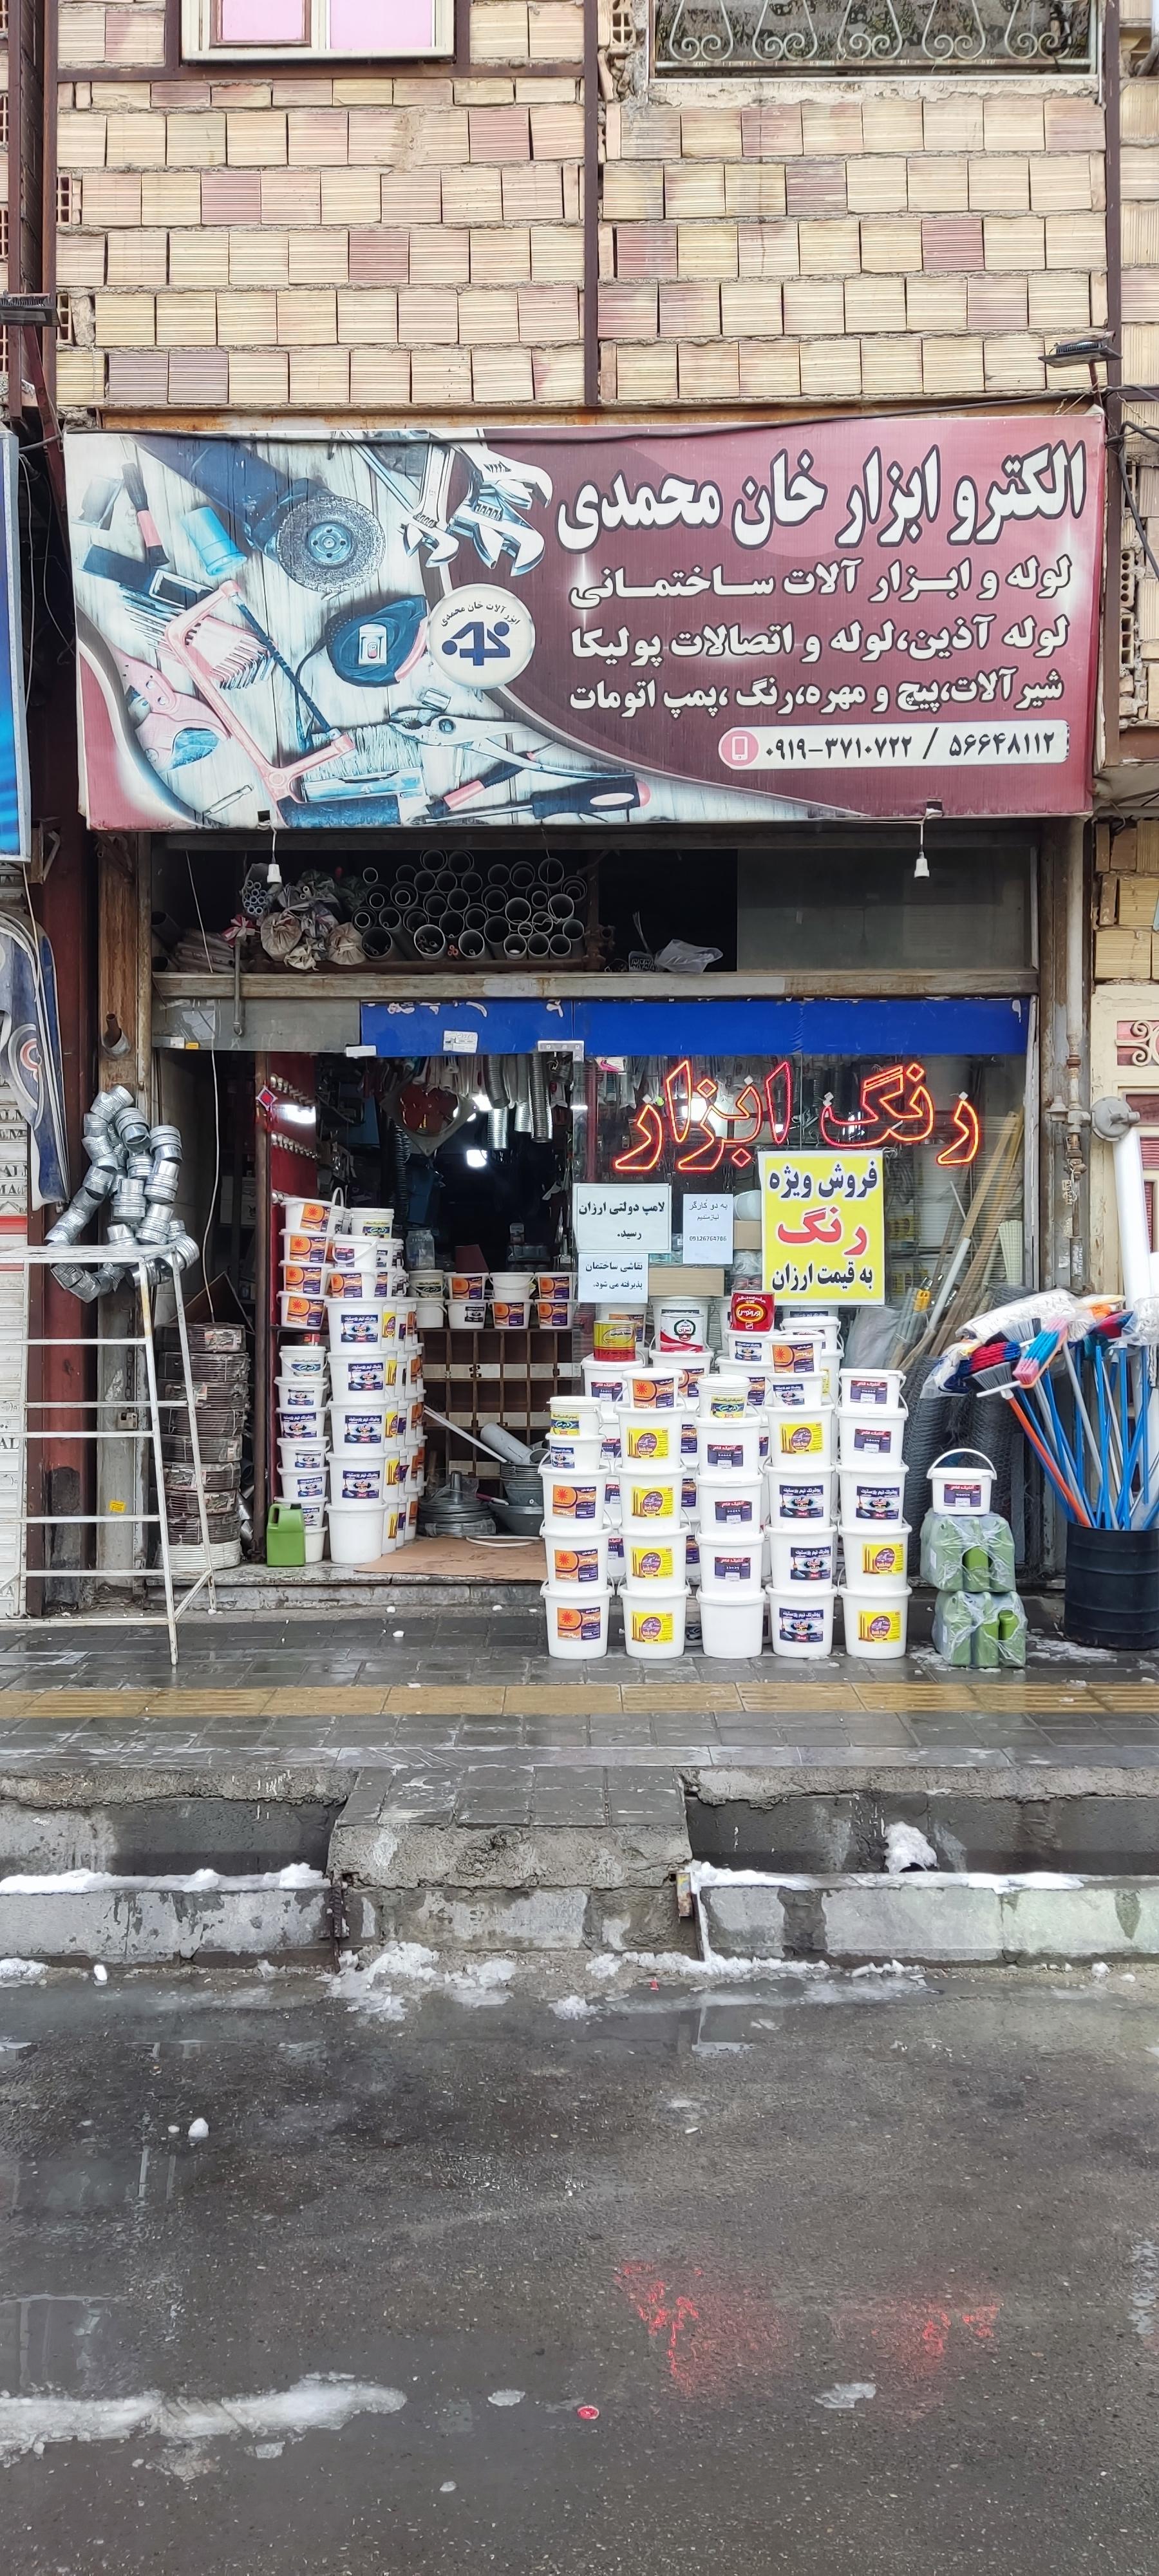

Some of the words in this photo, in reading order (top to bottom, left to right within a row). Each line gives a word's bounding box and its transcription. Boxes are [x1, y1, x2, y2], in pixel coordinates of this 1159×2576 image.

[731, 448, 828, 549] خان
[835, 445, 941, 547] ابزار
[947, 440, 1087, 545] الکترو
[556, 469, 723, 553] محمدی
[569, 564, 775, 609] ساختمانی
[782, 557, 864, 596] آلات
[869, 557, 971, 603] ابزار
[977, 570, 999, 600] و
[1006, 554, 1072, 599] لوله
[570, 625, 664, 668] پولیکا
[668, 622, 795, 656] اتصالات
[800, 634, 822, 663] و
[1002, 614, 1070, 658] لوله
[569, 679, 656, 719] اتومات
[871, 686, 890, 713] و
[949, 732, 1055, 758] ۵۶۶۴۸۱۱۲
[614, 1059, 793, 1171] ابزار
[820, 1063, 980, 1165] رنگ
[769, 1165, 813, 1198] ویژه
[818, 1160, 878, 1198] فروش
[579, 1201, 607, 1215] ارزان
[609, 1201, 639, 1215] دولتی
[642, 1201, 665, 1216] لامپ
[689, 1198, 708, 1211] کارگر
[710, 1202, 719, 1211] دو
[777, 1206, 868, 1256] رنگ
[585, 1261, 618, 1272] ساختمان
[620, 1261, 643, 1273] نقاشی
[772, 1262, 813, 1291] ارزان
[817, 1261, 855, 1289] قیمت
[859, 1267, 873, 1290] به
[620, 1280, 643, 1290] پذیرفته
